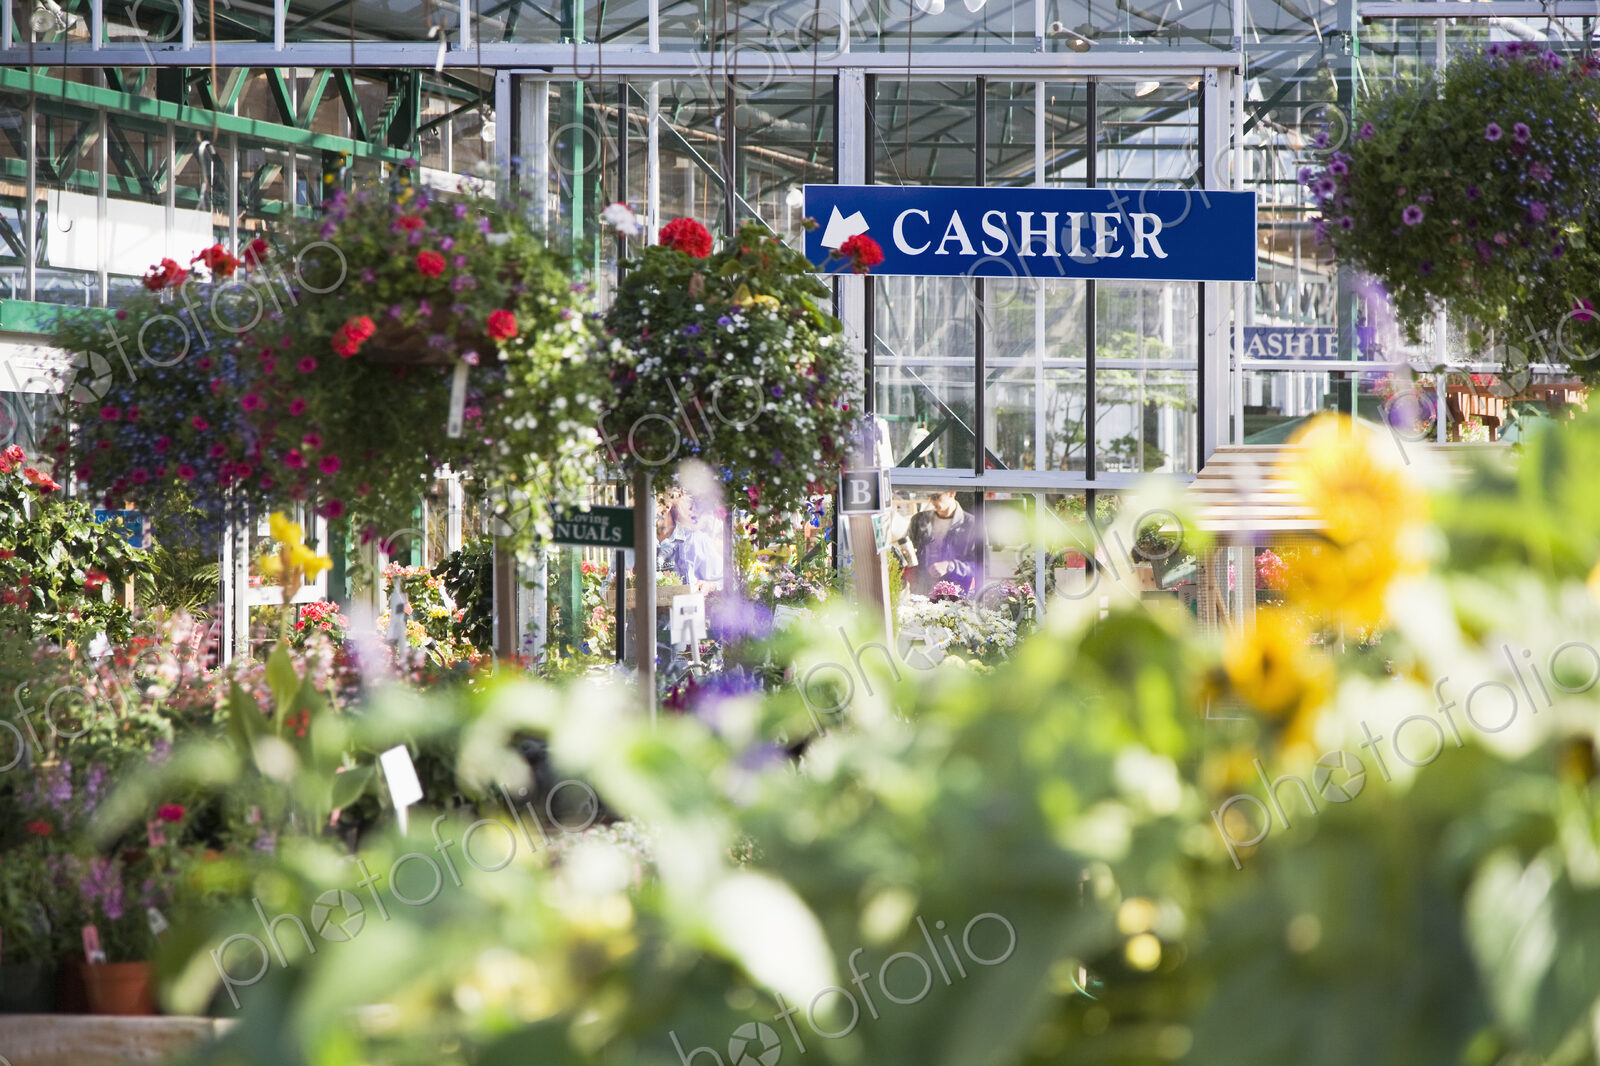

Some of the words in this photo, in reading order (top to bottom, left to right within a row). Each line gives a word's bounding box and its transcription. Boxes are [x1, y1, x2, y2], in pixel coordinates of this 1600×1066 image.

[892, 208, 1169, 259] CASHIER
[1230, 333, 1363, 357] ASHIE
[850, 480, 871, 505] B
[555, 523, 622, 542] NUALS
